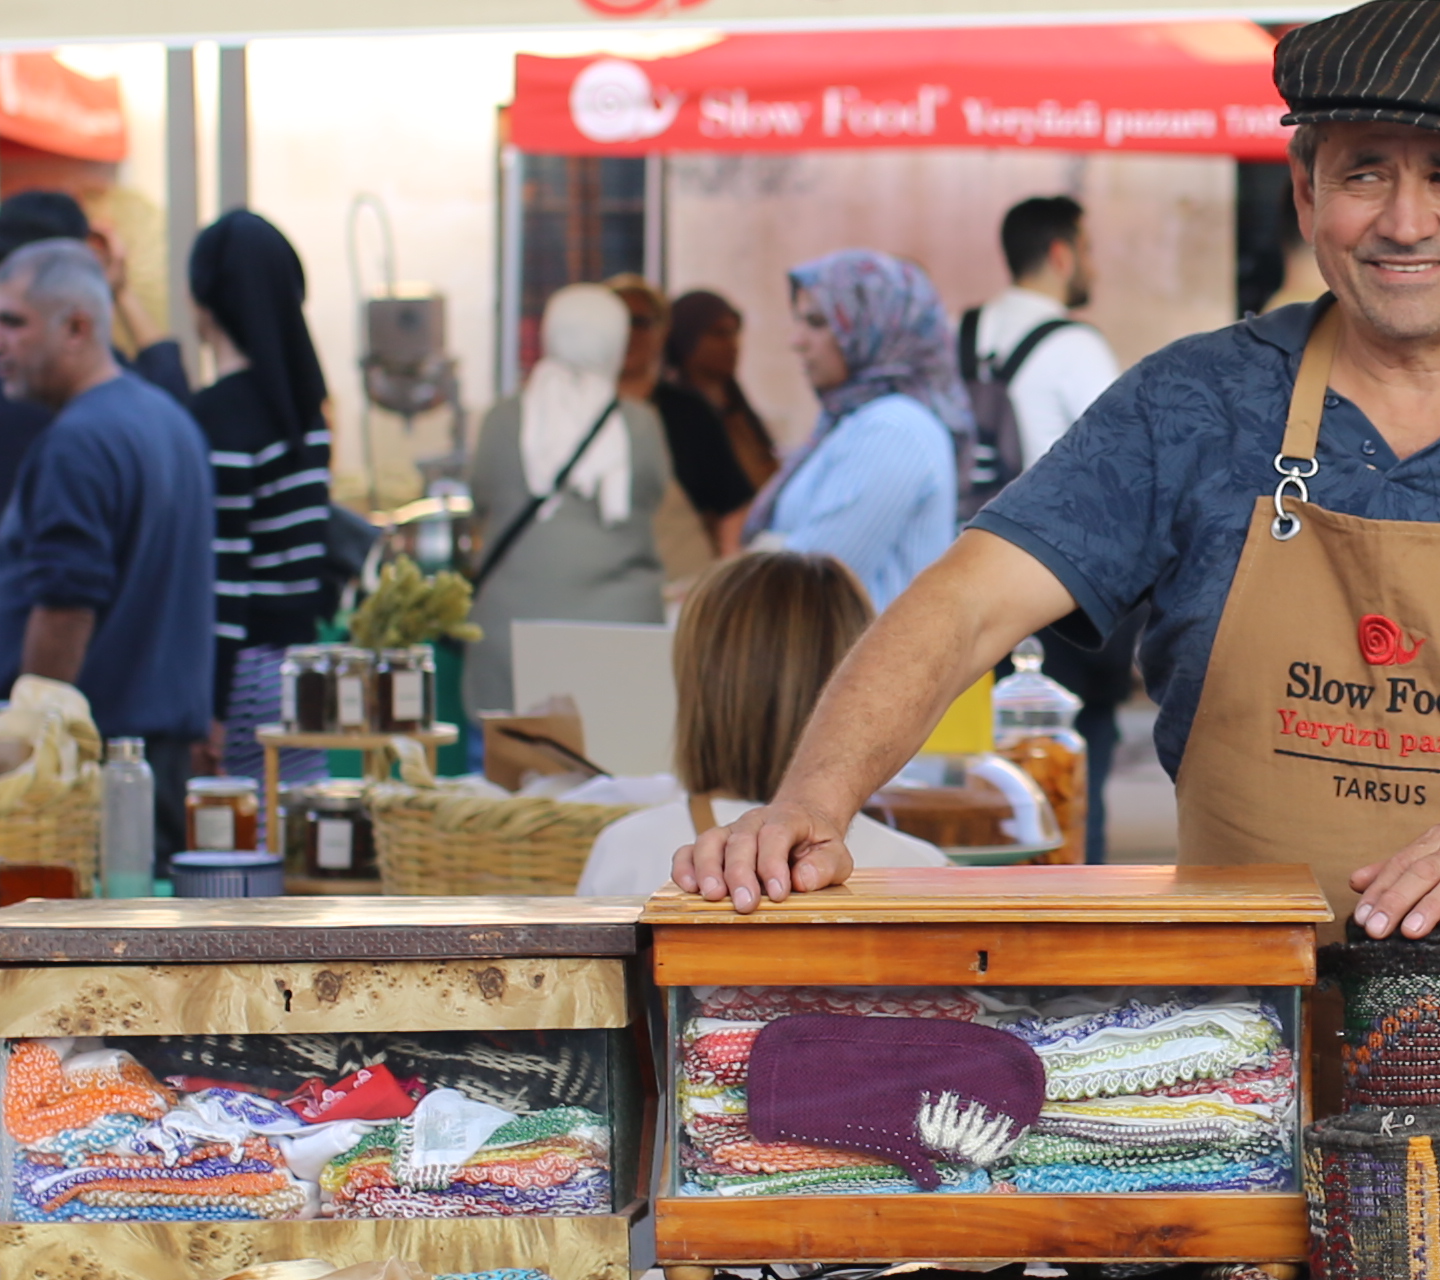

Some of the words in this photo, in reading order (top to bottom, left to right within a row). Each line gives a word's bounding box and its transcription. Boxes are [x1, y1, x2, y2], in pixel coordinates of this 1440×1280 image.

[1287, 661, 1375, 710] Slow
[1277, 709, 1391, 749] Yeryüzü
[1333, 776, 1427, 805] TARSUS
